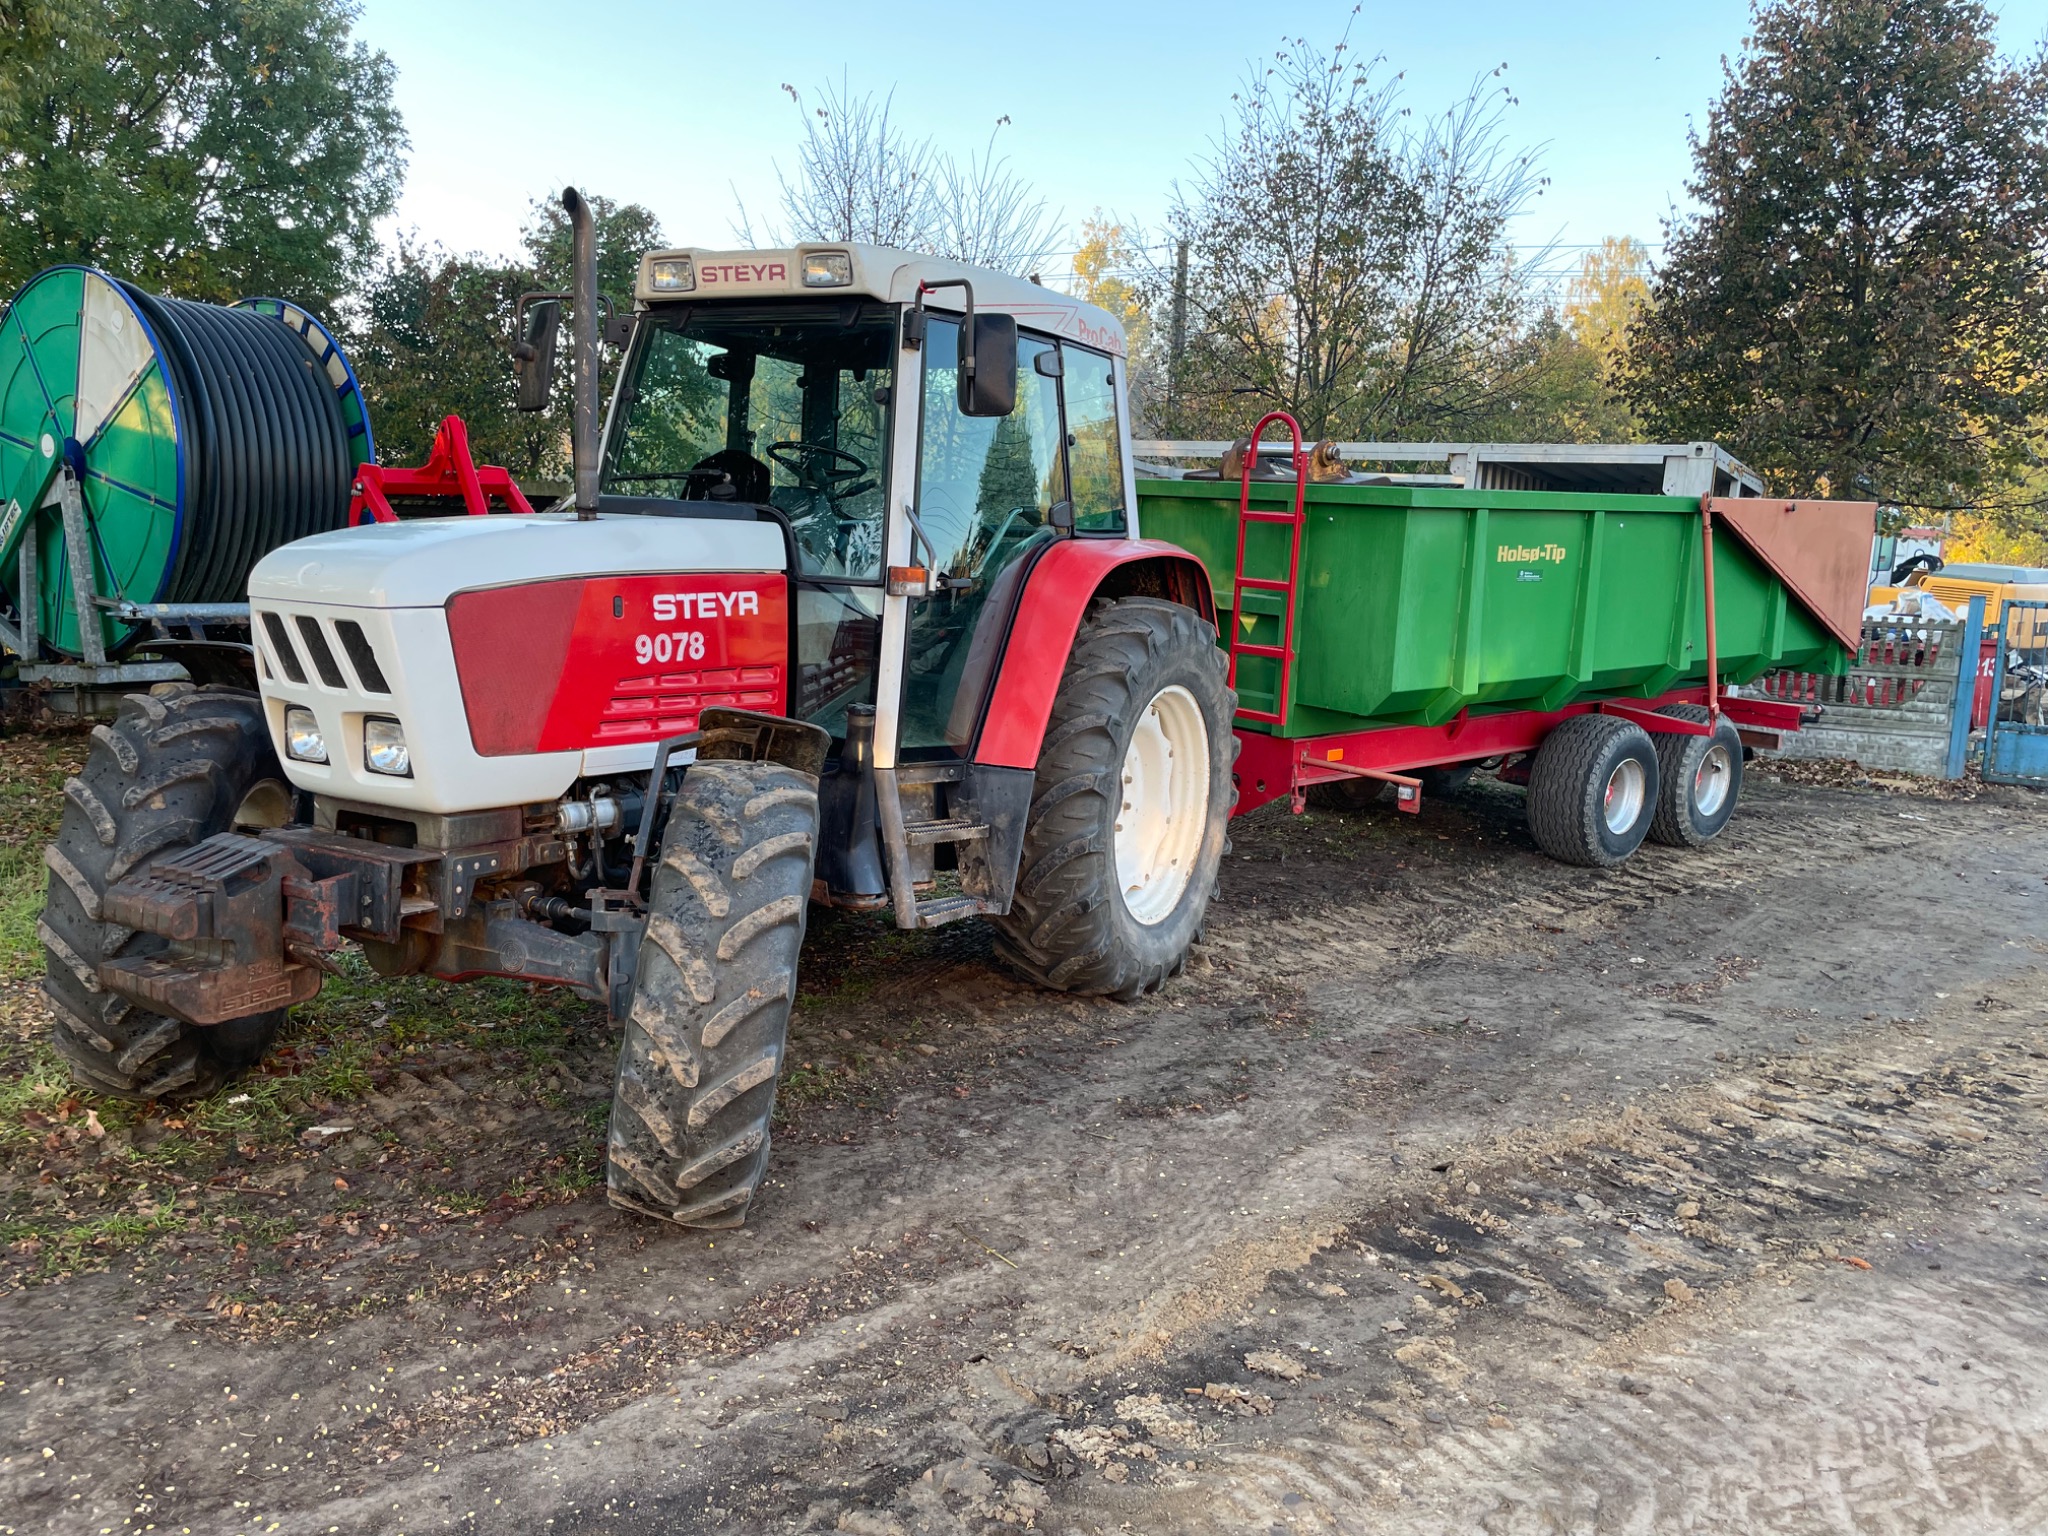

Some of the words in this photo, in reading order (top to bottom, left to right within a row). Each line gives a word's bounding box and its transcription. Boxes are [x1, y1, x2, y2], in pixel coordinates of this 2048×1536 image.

[701, 263, 786, 283] STEYR
[1078, 317, 1122, 351] ProCab
[1497, 544, 1566, 564] Holsø-Tip
[652, 590, 759, 621] STEYR
[635, 631, 705, 665] 9078
[1976, 657, 1996, 677] 13
[222, 981, 289, 1011] STEYR
